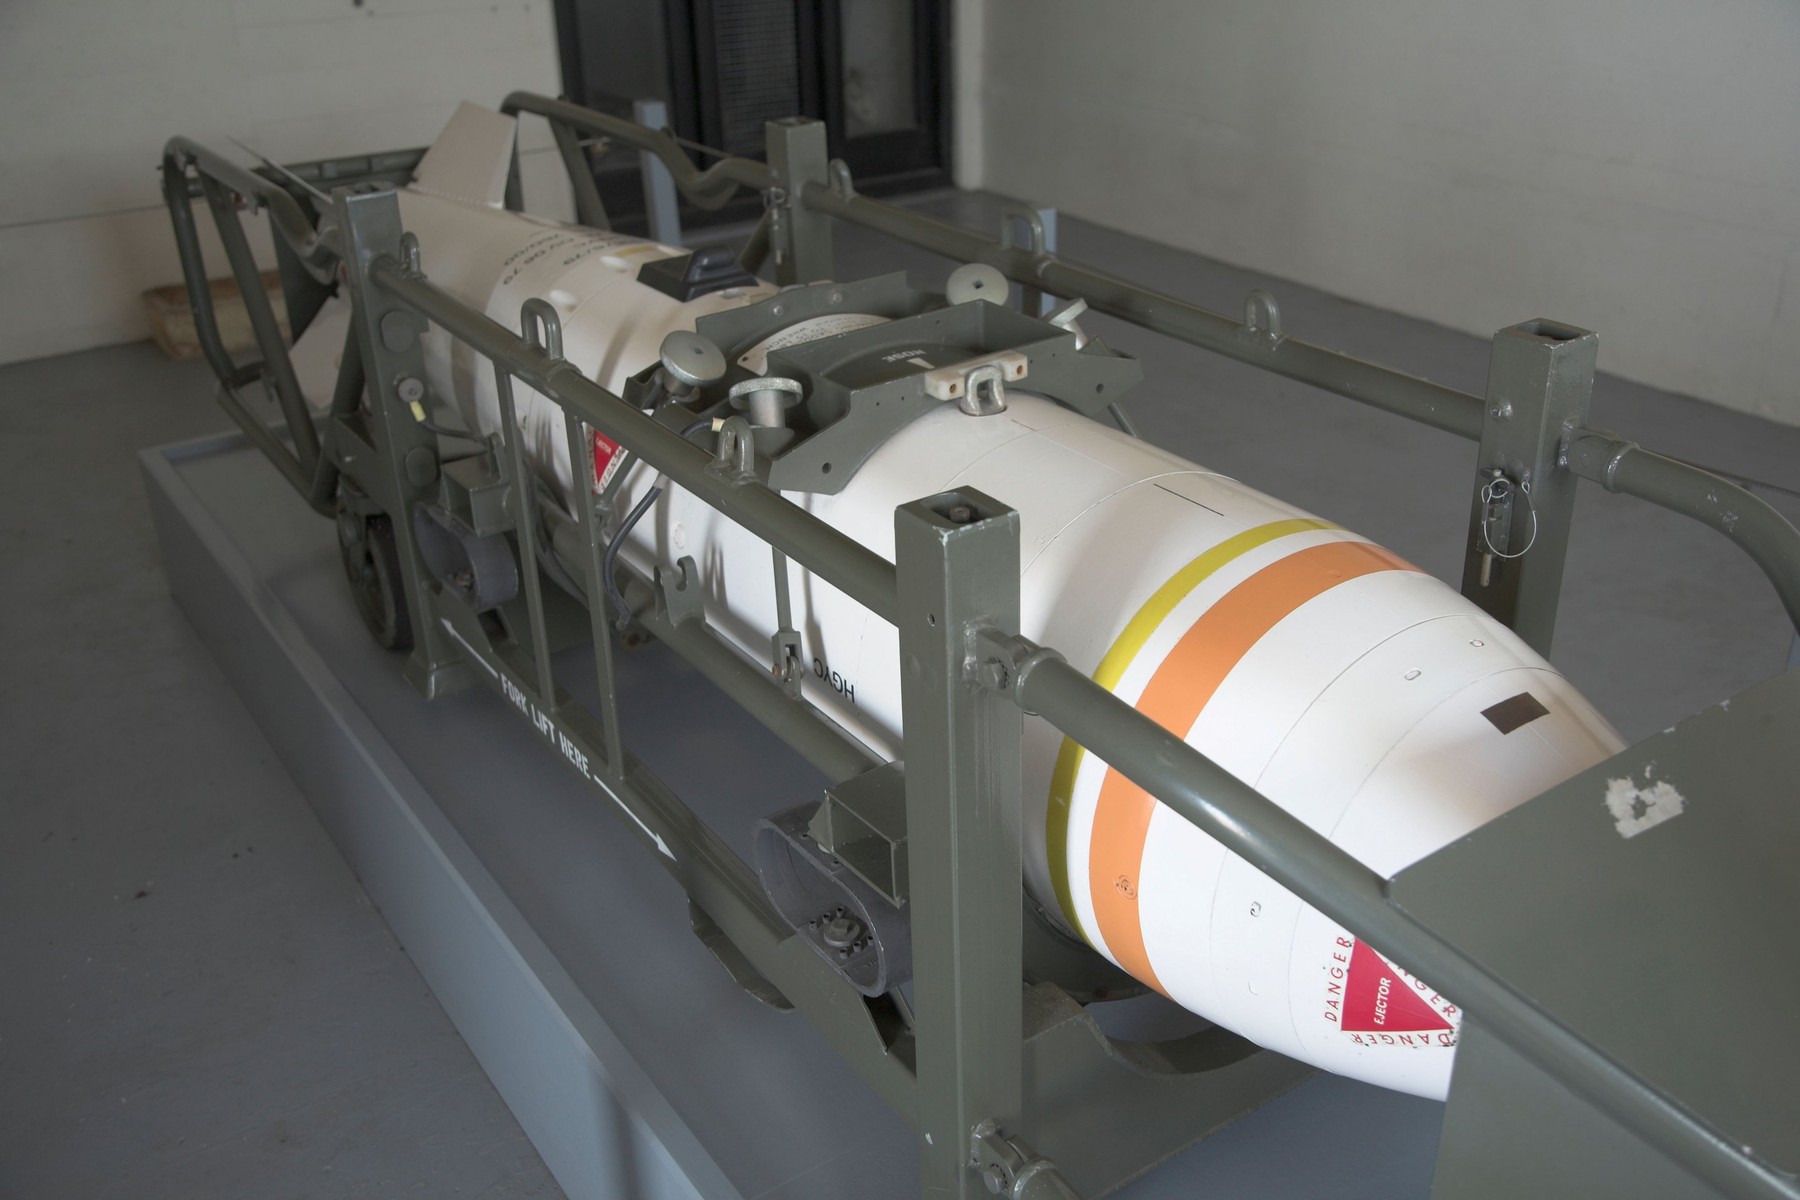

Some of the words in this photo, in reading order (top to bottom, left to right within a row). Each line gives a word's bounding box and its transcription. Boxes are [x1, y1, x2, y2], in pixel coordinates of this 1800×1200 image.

[881, 349, 927, 363] NOSE
[813, 657, 855, 704] HGYC
[501, 672, 529, 717] FORK
[531, 703, 555, 744] LIFT
[559, 731, 591, 780] HERE
[1324, 936, 1351, 1022] DANGER
[1373, 977, 1391, 1025] EJECTOR
[1351, 1033, 1452, 1046] DANGER
